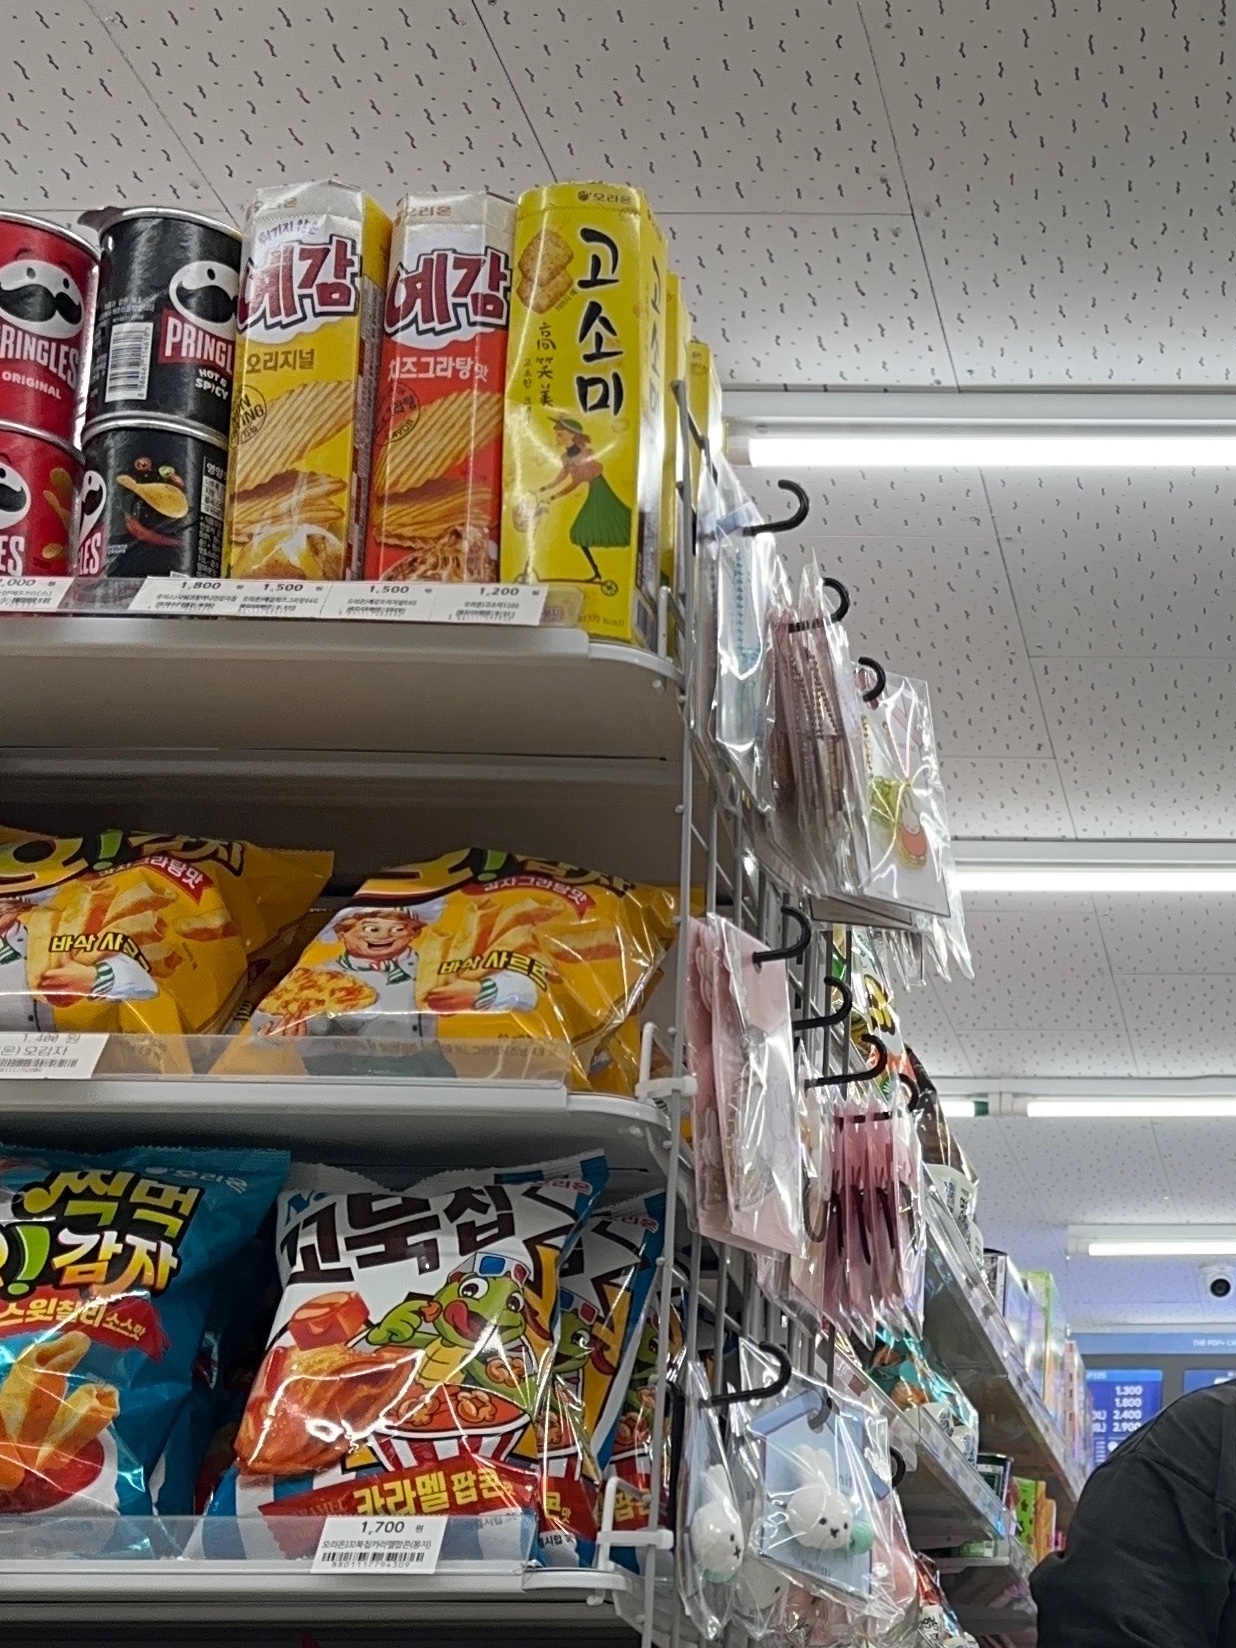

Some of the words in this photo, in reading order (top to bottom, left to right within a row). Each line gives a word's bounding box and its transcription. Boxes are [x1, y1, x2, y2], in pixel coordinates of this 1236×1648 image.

[237, 236, 358, 331] 예감
[384, 248, 510, 332] 예감
[576, 226, 625, 417] 고소미
[0, 323, 79, 390] RINGLES
[246, 350, 315, 373] 오리지널
[1, 370, 62, 400] ORIGINAL
[198, 368, 221, 382] HOT
[195, 377, 229, 400] SPICY
[181, 582, 222, 591] 1,800
[369, 585, 410, 595] 1,500
[479, 587, 520, 597] 1,200
[51, 934, 95, 952] 바삭
[440, 955, 483, 976] 바삭
[485, 950, 549, 992] 사르르
[352, 1472, 449, 1517] 카라멜
[360, 1520, 406, 1536] 1,700
